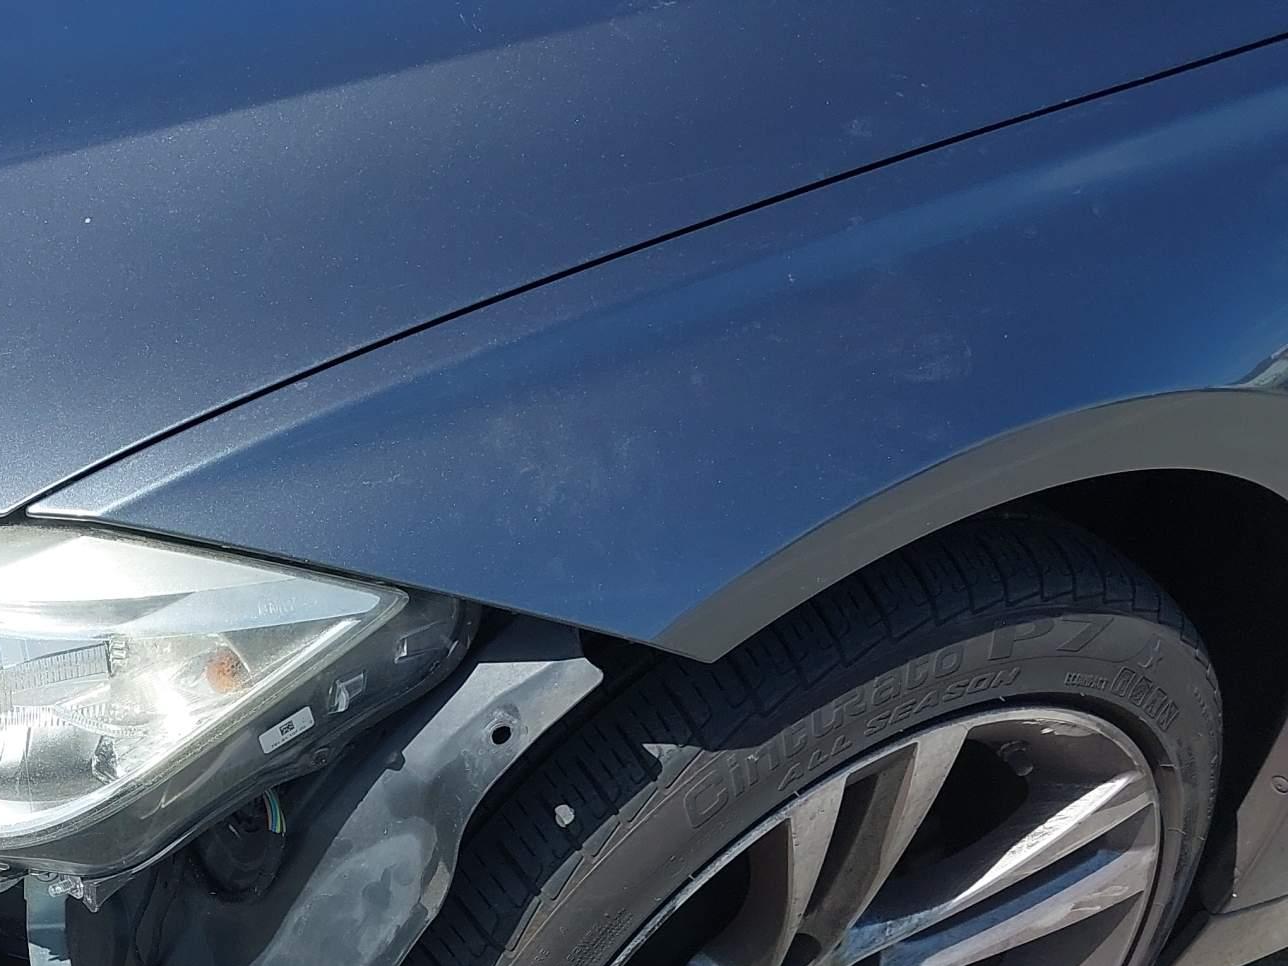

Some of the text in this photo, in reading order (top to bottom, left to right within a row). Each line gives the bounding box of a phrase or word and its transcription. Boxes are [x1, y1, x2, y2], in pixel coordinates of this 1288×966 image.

[683, 614, 1115, 829] Cinturato P7
[777, 667, 1023, 791] ALL SEASON
